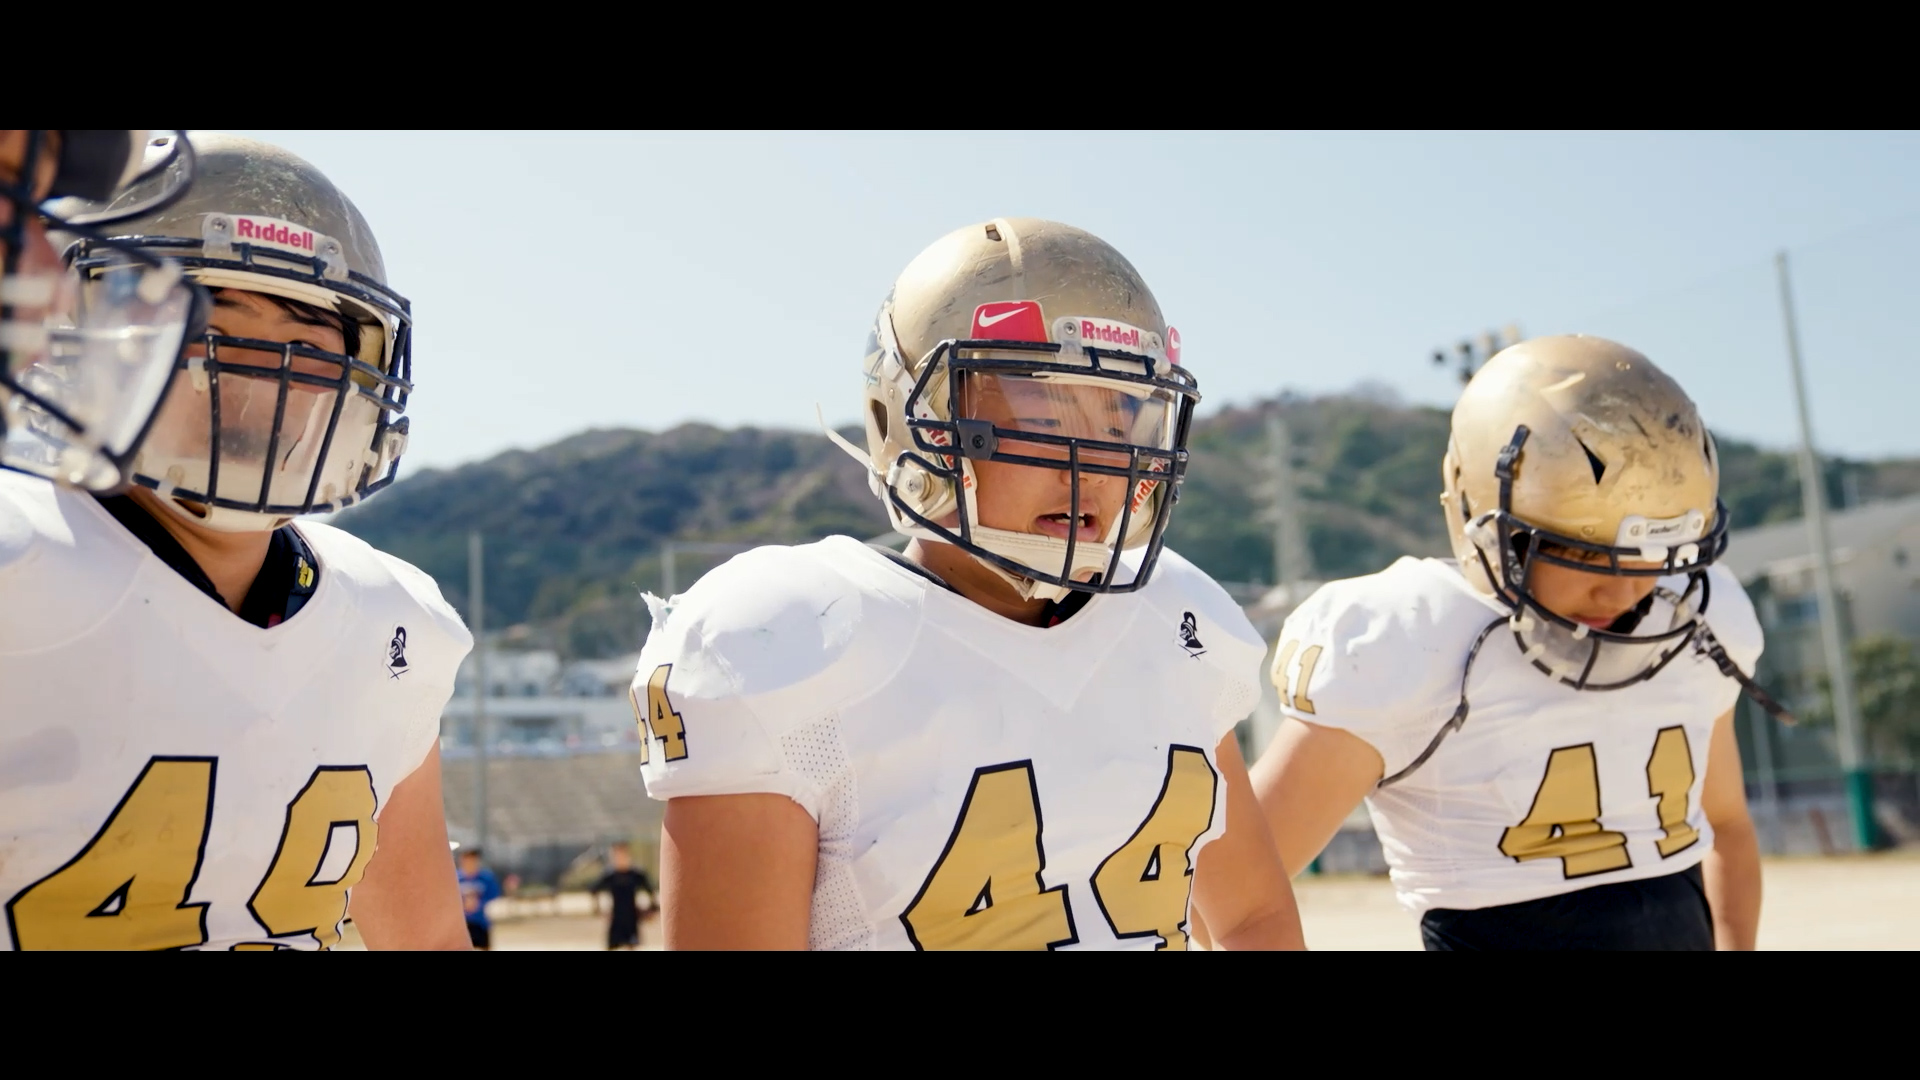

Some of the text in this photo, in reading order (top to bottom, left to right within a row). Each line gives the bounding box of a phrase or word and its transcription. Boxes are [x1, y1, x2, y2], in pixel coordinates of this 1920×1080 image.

[237, 218, 314, 252] Riddell
[1081, 320, 1140, 347] Riddell
[925, 427, 972, 489] Rill
[1271, 639, 1324, 716] 41
[1498, 724, 1700, 880] 41
[899, 743, 1218, 951] 44
